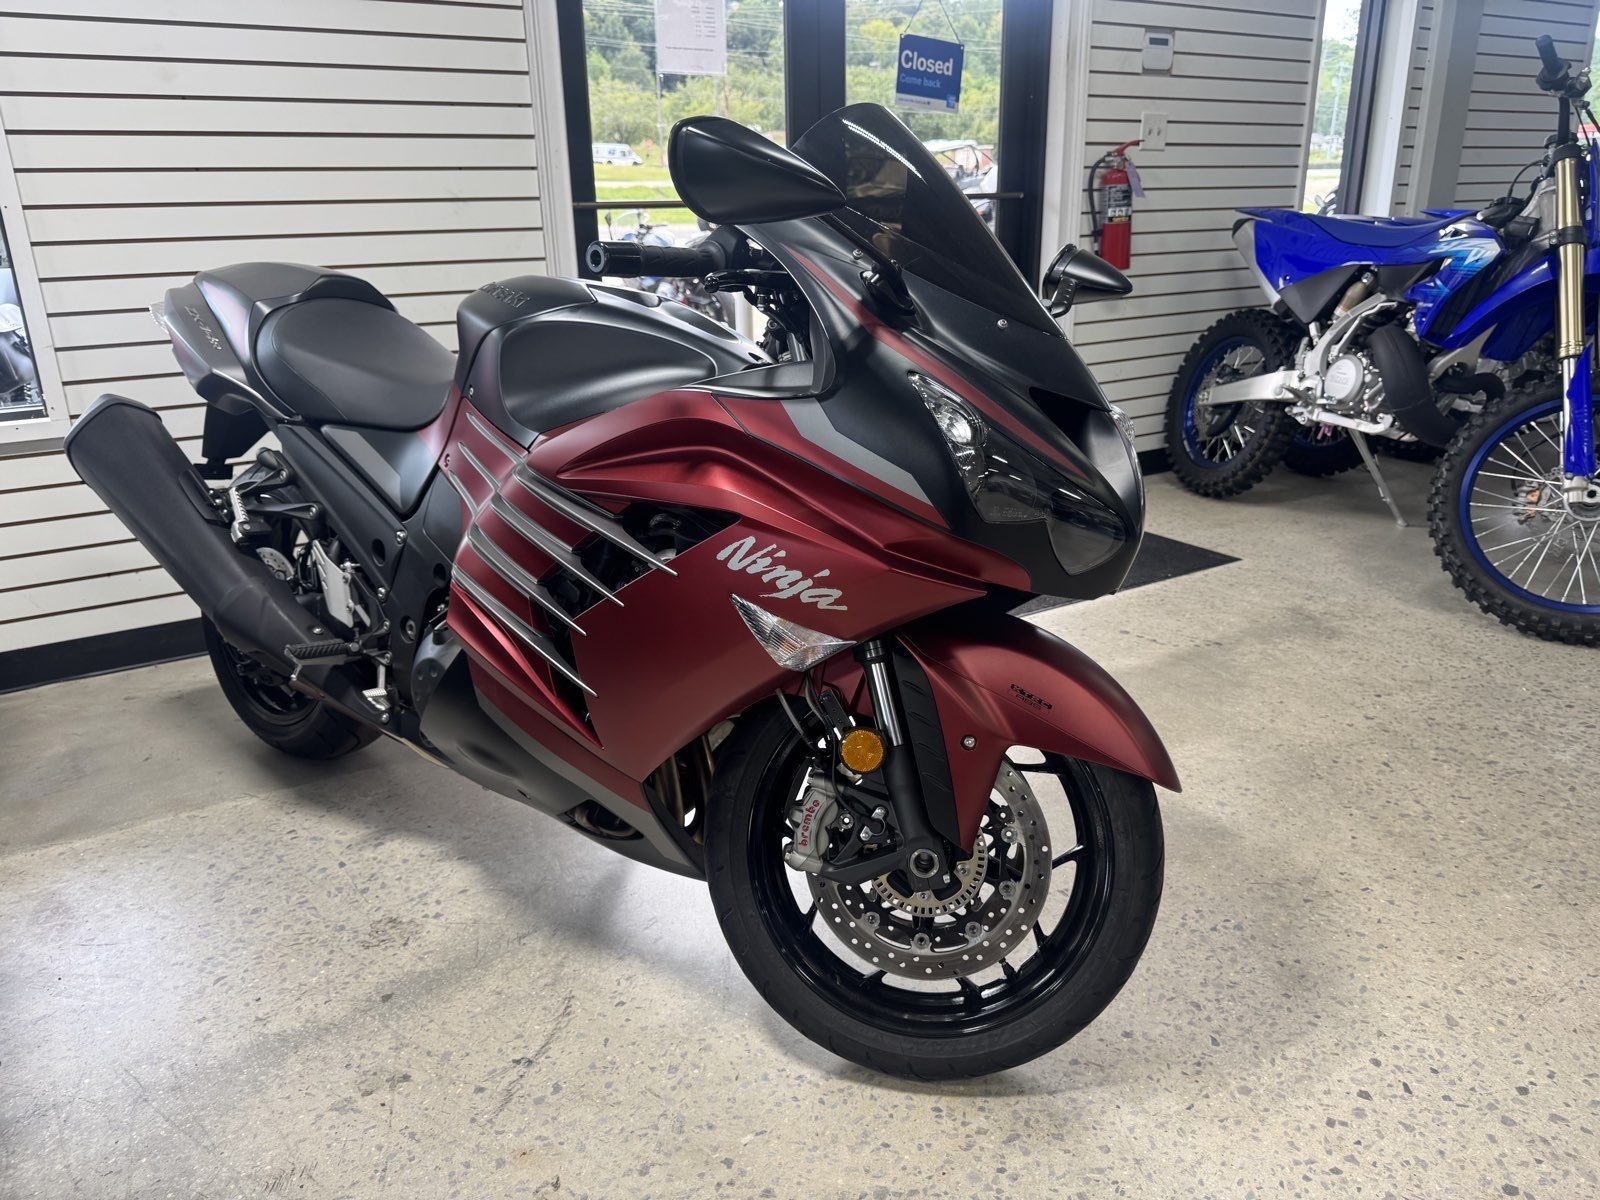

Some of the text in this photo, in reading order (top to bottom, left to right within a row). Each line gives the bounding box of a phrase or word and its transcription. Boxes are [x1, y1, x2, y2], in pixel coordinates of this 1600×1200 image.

[900, 49, 954, 76] Closed
[923, 76, 941, 88] back
[716, 535, 848, 611] Ninja
[799, 799, 820, 847] brembo
